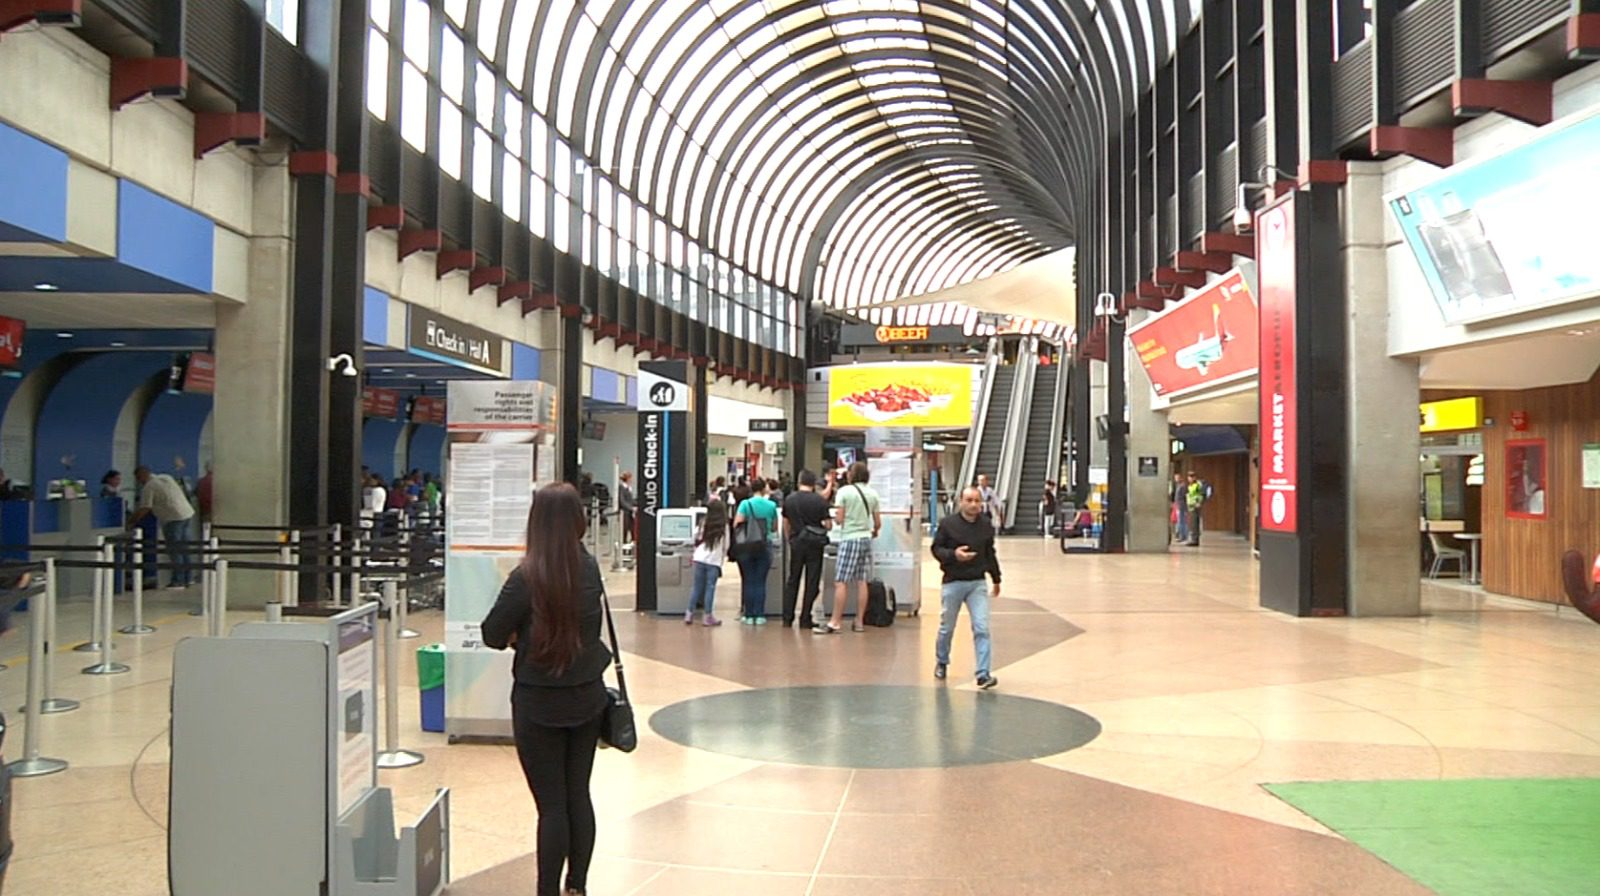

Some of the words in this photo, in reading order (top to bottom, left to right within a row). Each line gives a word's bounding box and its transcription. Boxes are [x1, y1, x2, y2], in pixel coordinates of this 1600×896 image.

[889, 326, 929, 341] BEER
[494, 391, 533, 399] Passenger
[644, 414, 658, 479] Check-In
[1272, 393, 1285, 474] MARKET
[644, 481, 658, 516] Auto
